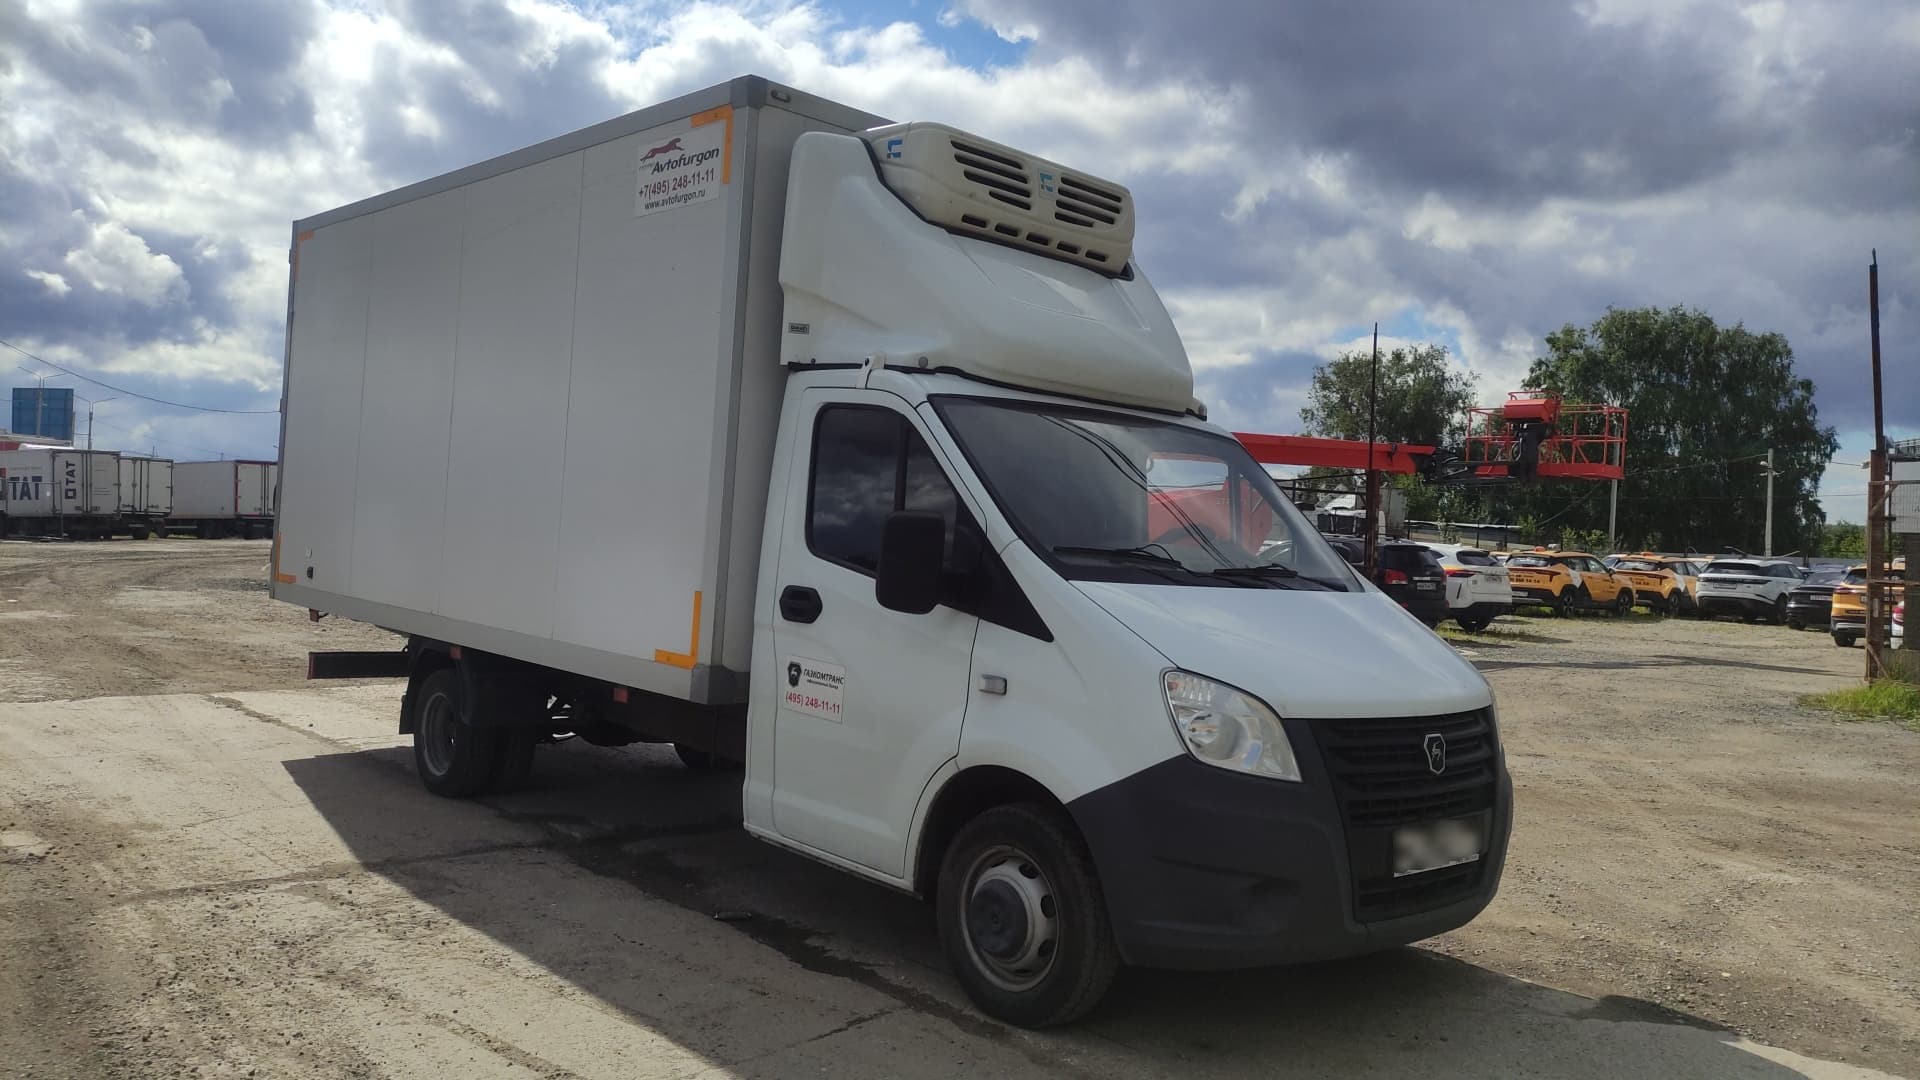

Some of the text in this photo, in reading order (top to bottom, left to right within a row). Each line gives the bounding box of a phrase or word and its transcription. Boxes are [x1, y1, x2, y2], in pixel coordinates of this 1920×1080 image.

[651, 147, 720, 175] Avtofurgon
[638, 167, 715, 200] +7(495) 248-11-11
[644, 189, 706, 209] www.avtofurgon.ru
[803, 668, 845, 686] ГАЗКОМТРАНС
[785, 690, 841, 714] (495) 248-11-11
